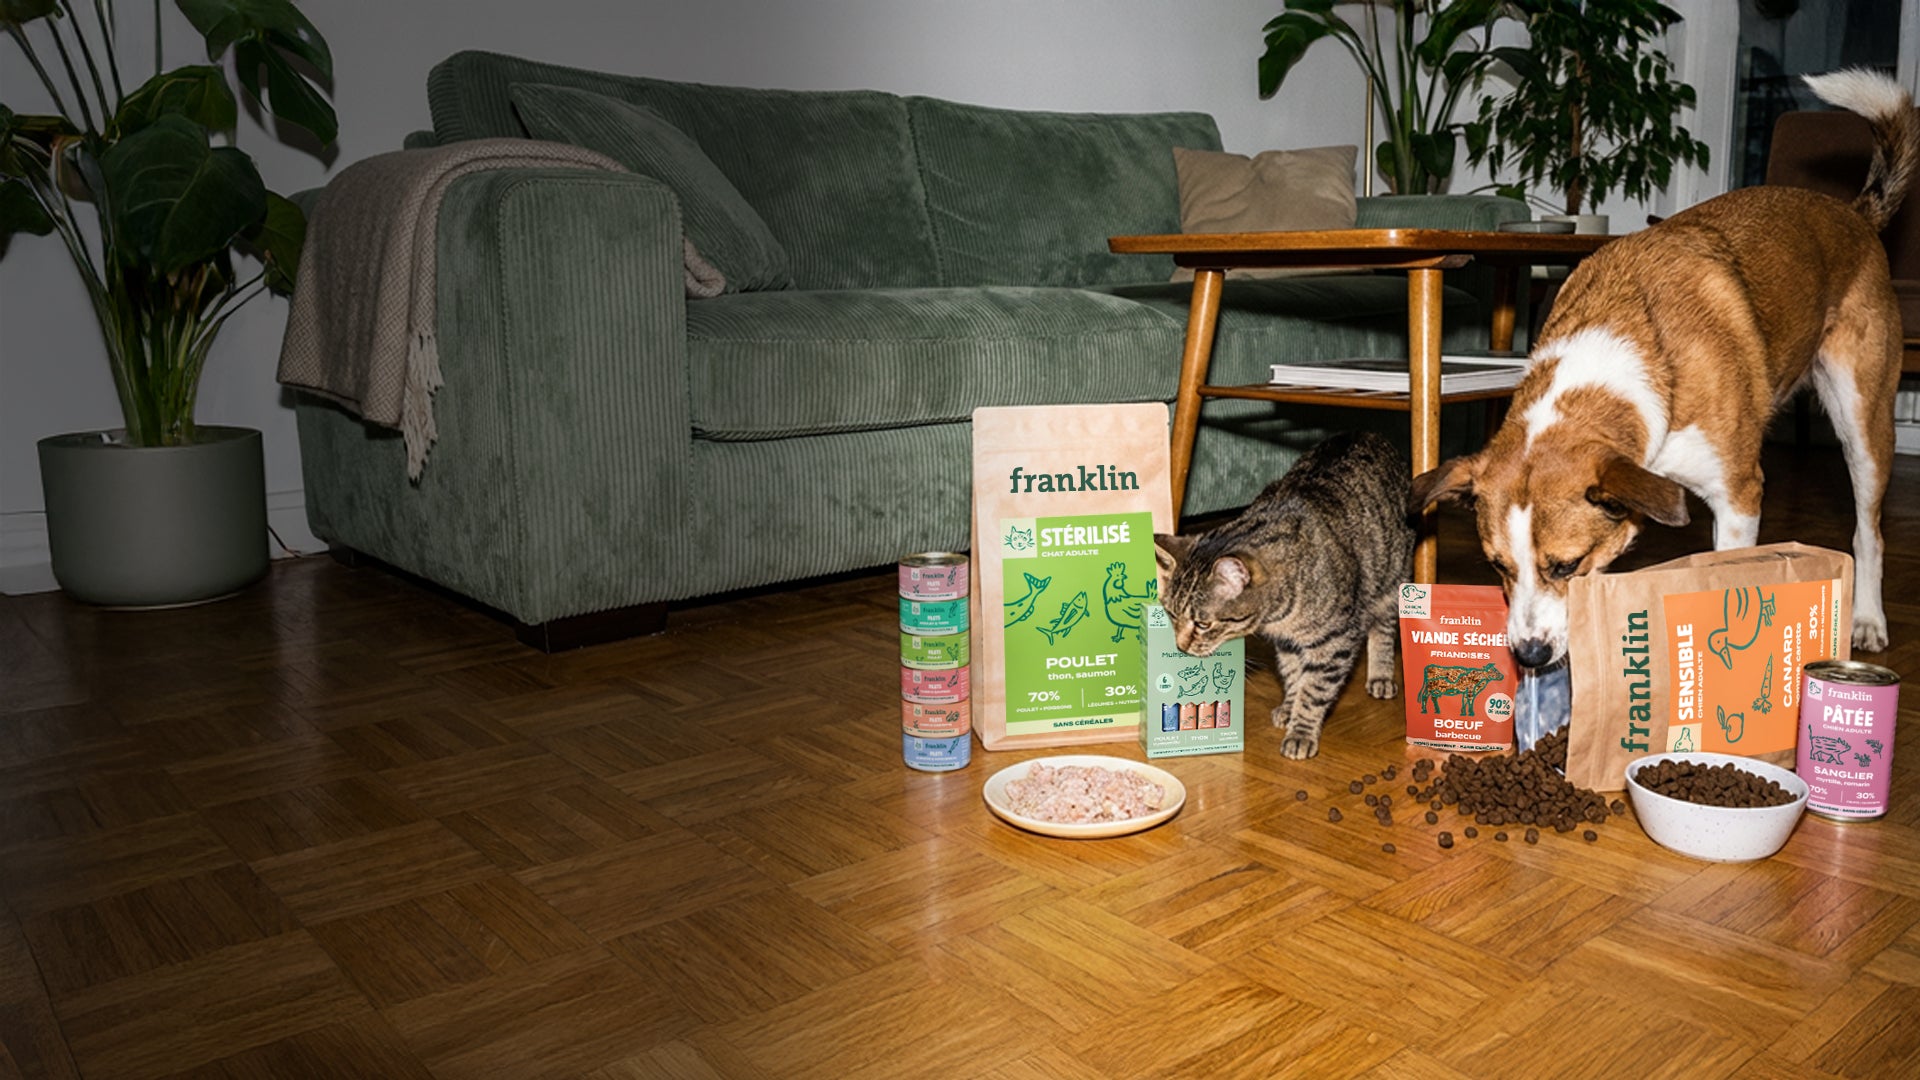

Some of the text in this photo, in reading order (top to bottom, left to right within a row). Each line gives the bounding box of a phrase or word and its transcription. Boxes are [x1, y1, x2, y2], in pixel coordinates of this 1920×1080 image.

[1010, 465, 1139, 493] franklin
[1041, 521, 1131, 547] STÉRILISÉ
[1440, 615, 1482, 626] franklin
[1809, 604, 1818, 640] 30%
[1411, 630, 1459, 644] VIANDE
[1046, 653, 1118, 670] POULET
[1430, 650, 1490, 660] FRIANDISES
[1676, 624, 1694, 720] SENSIBLE
[1783, 625, 1793, 708] CANARD
[1048, 669, 1116, 681] thon, saumon
[1620, 610, 1651, 752] franklin
[1028, 690, 1060, 702] 70%
[1104, 684, 1138, 697] 30%
[1828, 687, 1873, 702] franklin
[1489, 698, 1510, 710] 90%
[1075, 718, 1114, 726] CÉRÉALES
[1823, 704, 1874, 727] PÂTÉE
[1434, 719, 1484, 730] BOEUF
[1823, 724, 1844, 732] CHIEN
[1435, 730, 1482, 740] barbecue
[1814, 766, 1874, 780] SANGLIER
[1816, 777, 1842, 786] myrtille,
[1810, 784, 1828, 795] 70%
